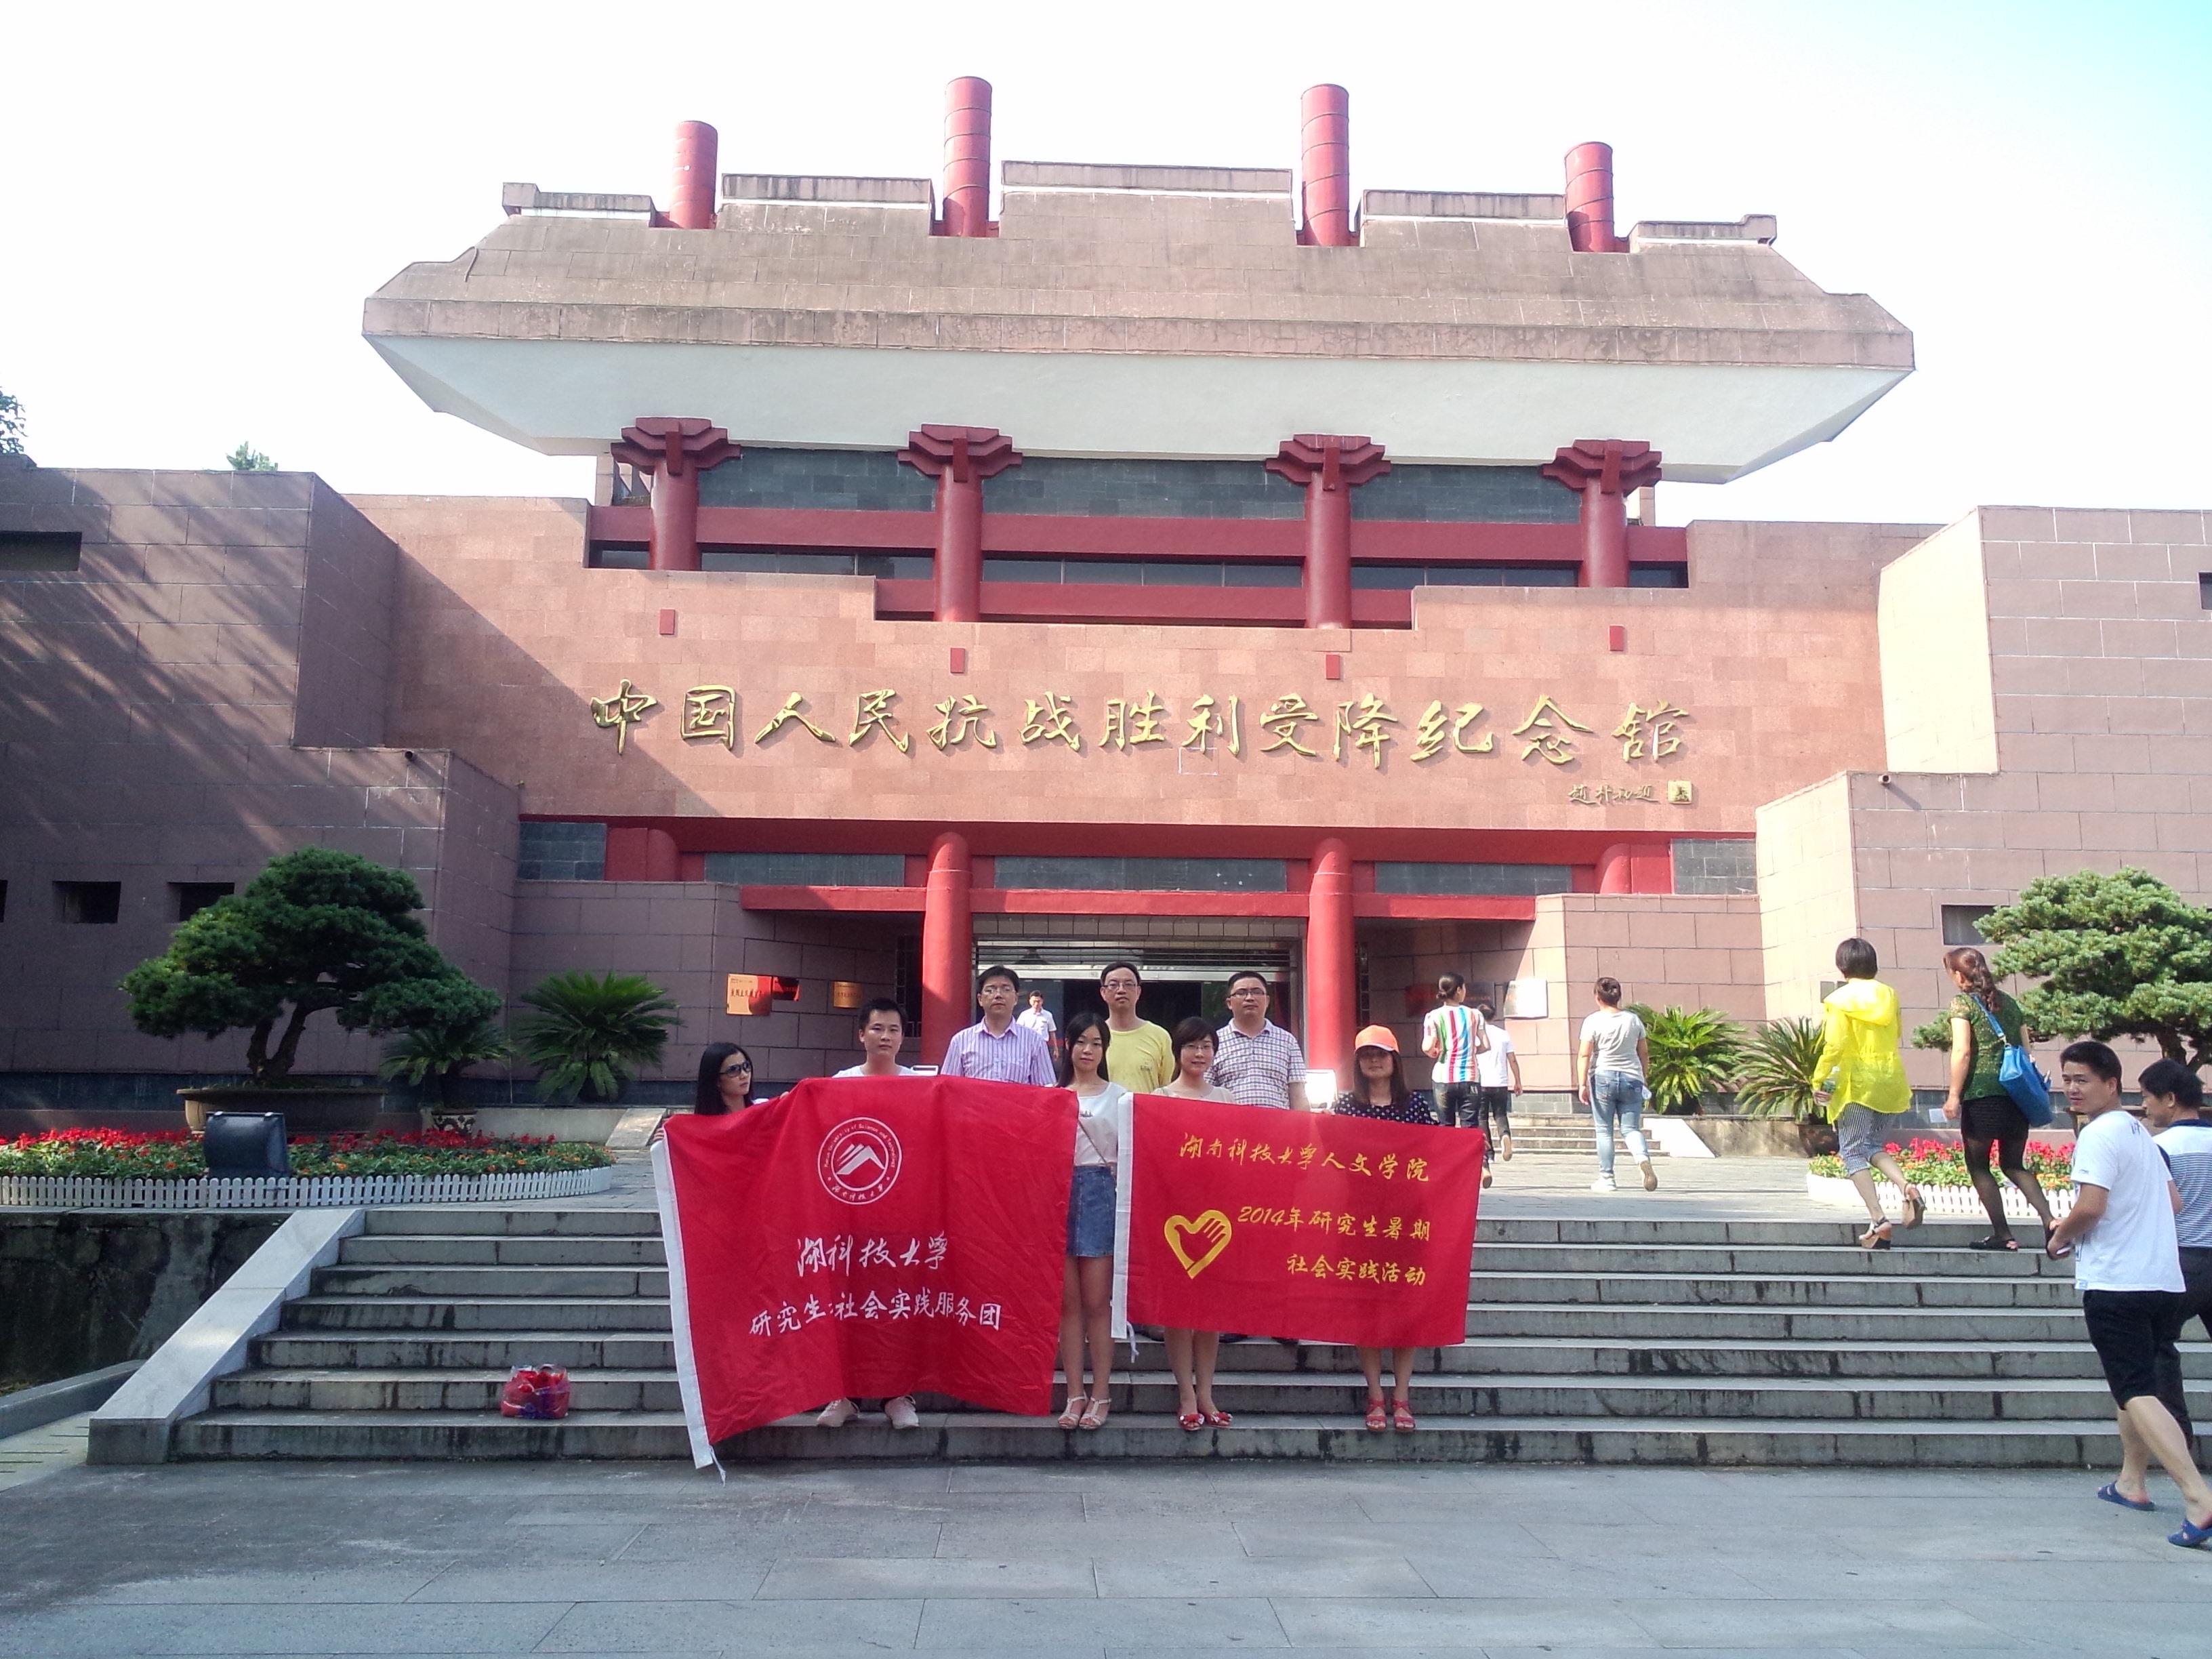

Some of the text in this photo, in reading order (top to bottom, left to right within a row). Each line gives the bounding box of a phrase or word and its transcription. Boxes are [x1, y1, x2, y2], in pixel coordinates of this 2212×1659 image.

[1287, 1254, 1425, 1285] 社会实践活动
[750, 1287, 1002, 1336] 研究生社会实践服务团
